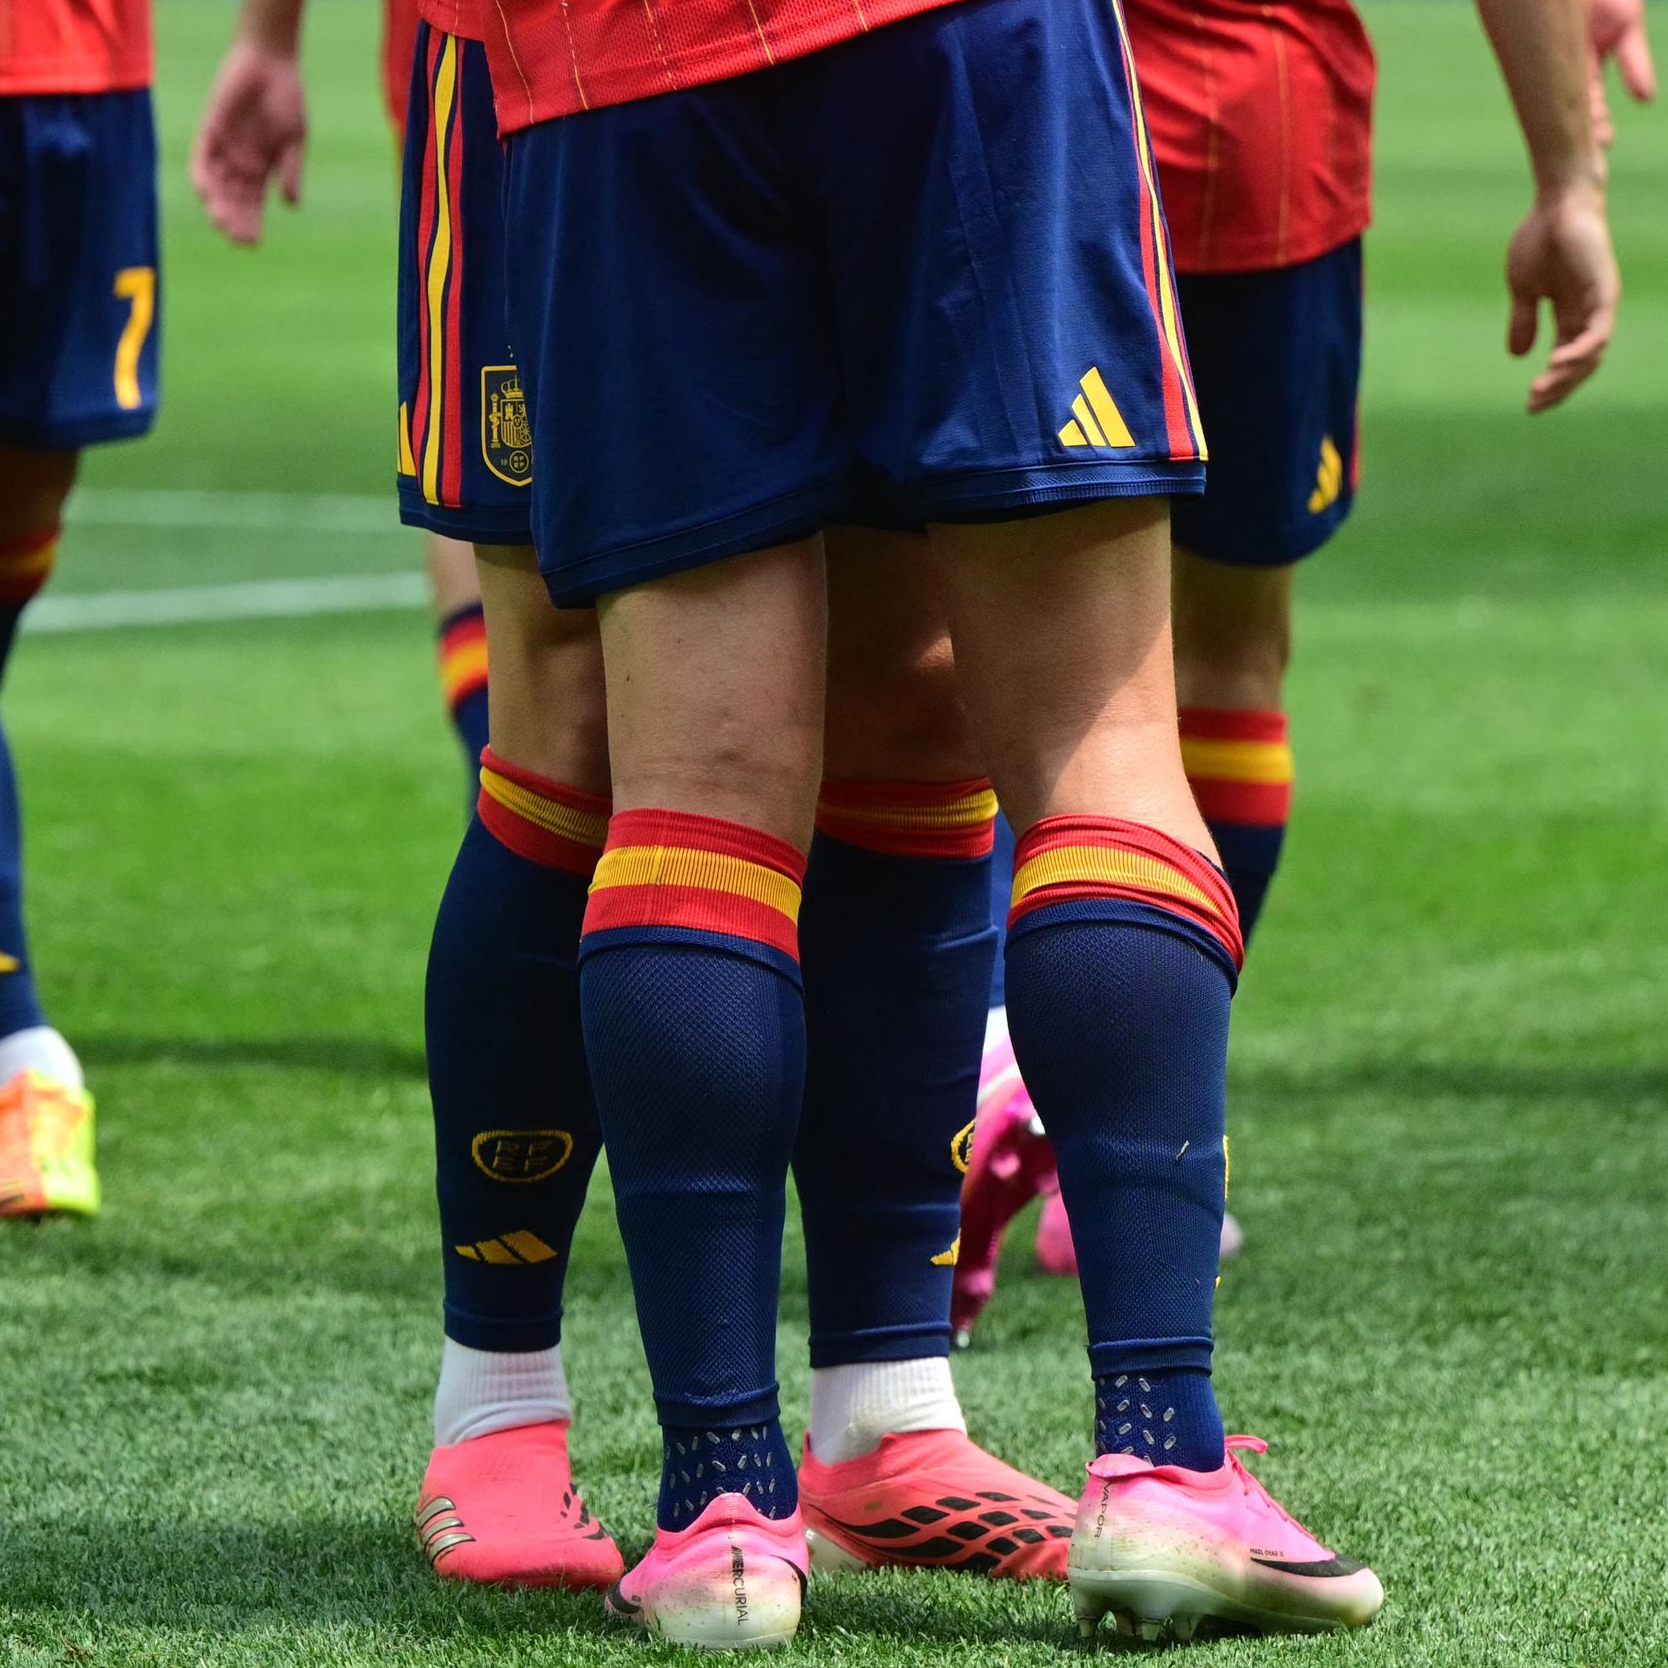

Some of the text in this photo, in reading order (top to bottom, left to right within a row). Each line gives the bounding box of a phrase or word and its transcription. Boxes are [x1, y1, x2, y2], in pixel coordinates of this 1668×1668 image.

[113, 267, 156, 410] 7
[1094, 1481, 1110, 1539] VAPOR
[731, 1544, 750, 1627] MERCURIAL
